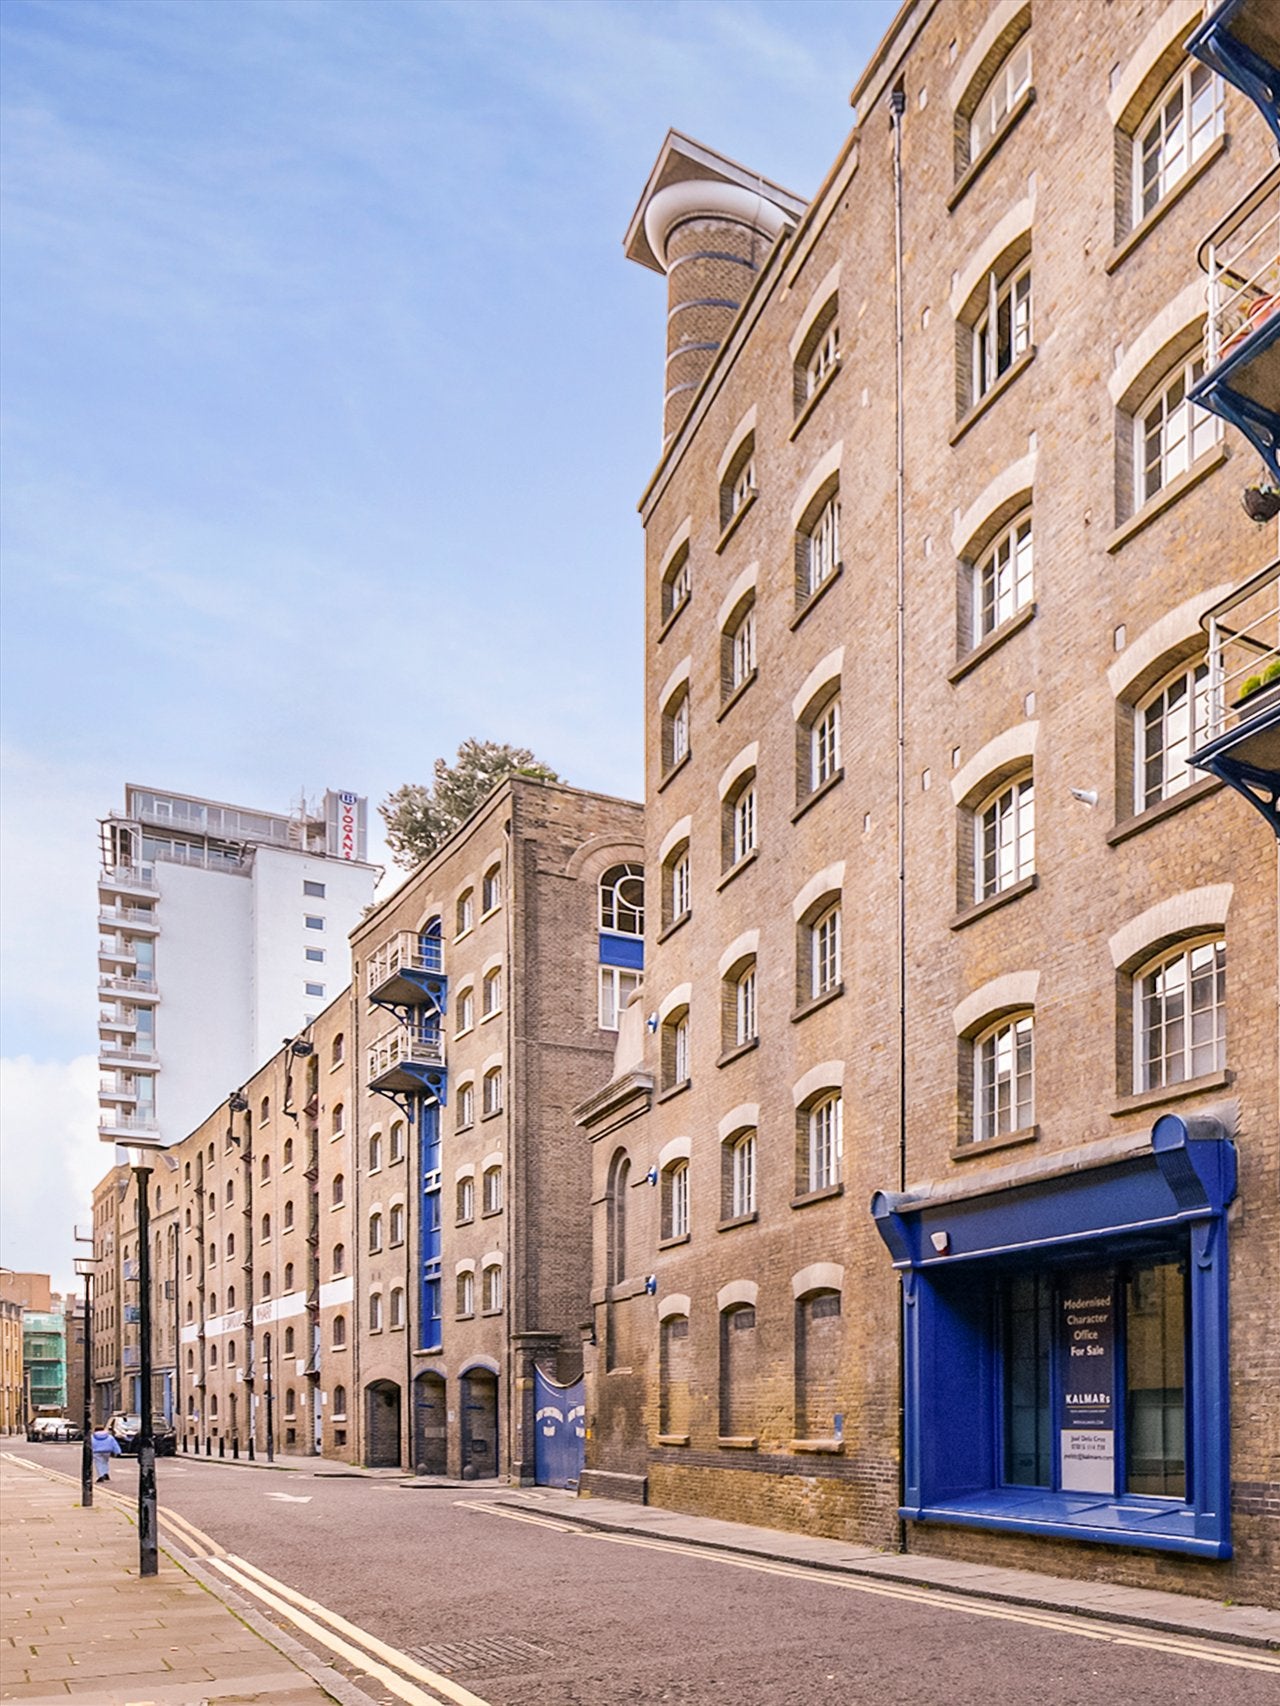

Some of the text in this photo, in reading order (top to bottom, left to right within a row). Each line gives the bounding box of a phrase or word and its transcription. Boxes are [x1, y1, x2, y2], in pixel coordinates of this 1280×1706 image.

[342, 805, 354, 860] VOGANS
[1064, 1295, 1111, 1310] Modernised
[1066, 1314, 1109, 1326] Character
[1074, 1329, 1099, 1341] Office
[1071, 1345, 1105, 1356] For Sale
